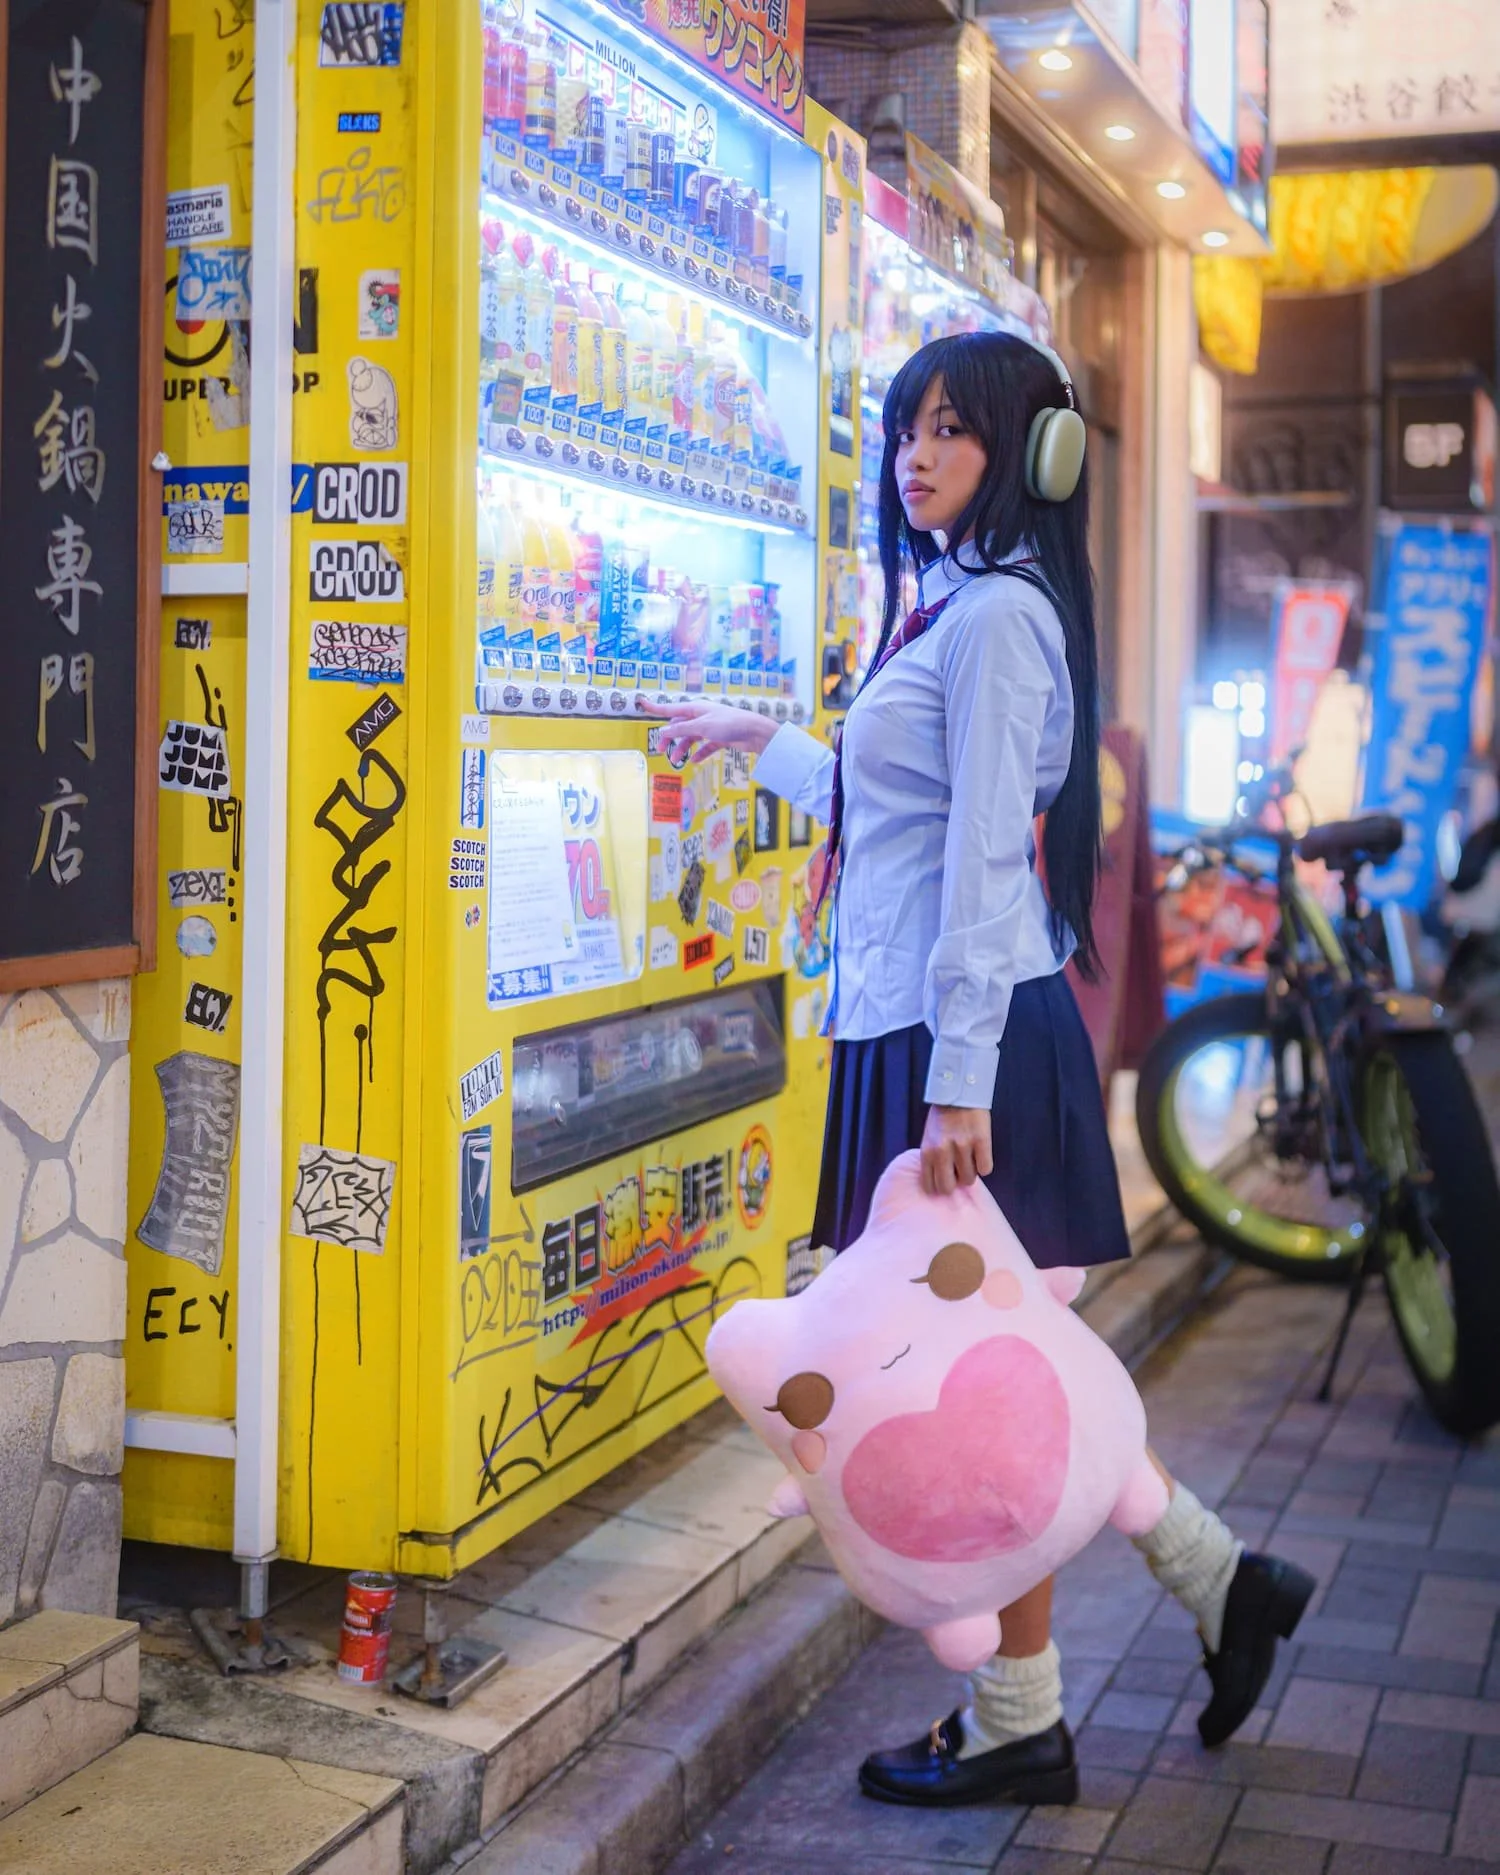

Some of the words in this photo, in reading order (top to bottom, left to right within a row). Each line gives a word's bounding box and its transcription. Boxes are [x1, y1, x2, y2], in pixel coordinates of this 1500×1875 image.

[595, 39, 636, 79] MILLION
[703, 0, 803, 113] ワンコイン
[1326, 73, 1500, 123] 渋谷餃
[167, 211, 216, 228] HANDLE
[192, 220, 225, 235] CARE
[317, 466, 401, 520] CROD
[314, 544, 401, 598] CROD
[611, 554, 621, 614] WATER
[353, 697, 395, 747] AMG
[463, 719, 489, 735] AMG
[160, 764, 229, 791] JUMP
[452, 838, 486, 856] SCOTCH
[450, 856, 485, 874] SCOTCH
[449, 874, 484, 890] SCOTCH
[461, 1051, 501, 1101] TONTO
[480, 1084, 494, 1108] SUA
